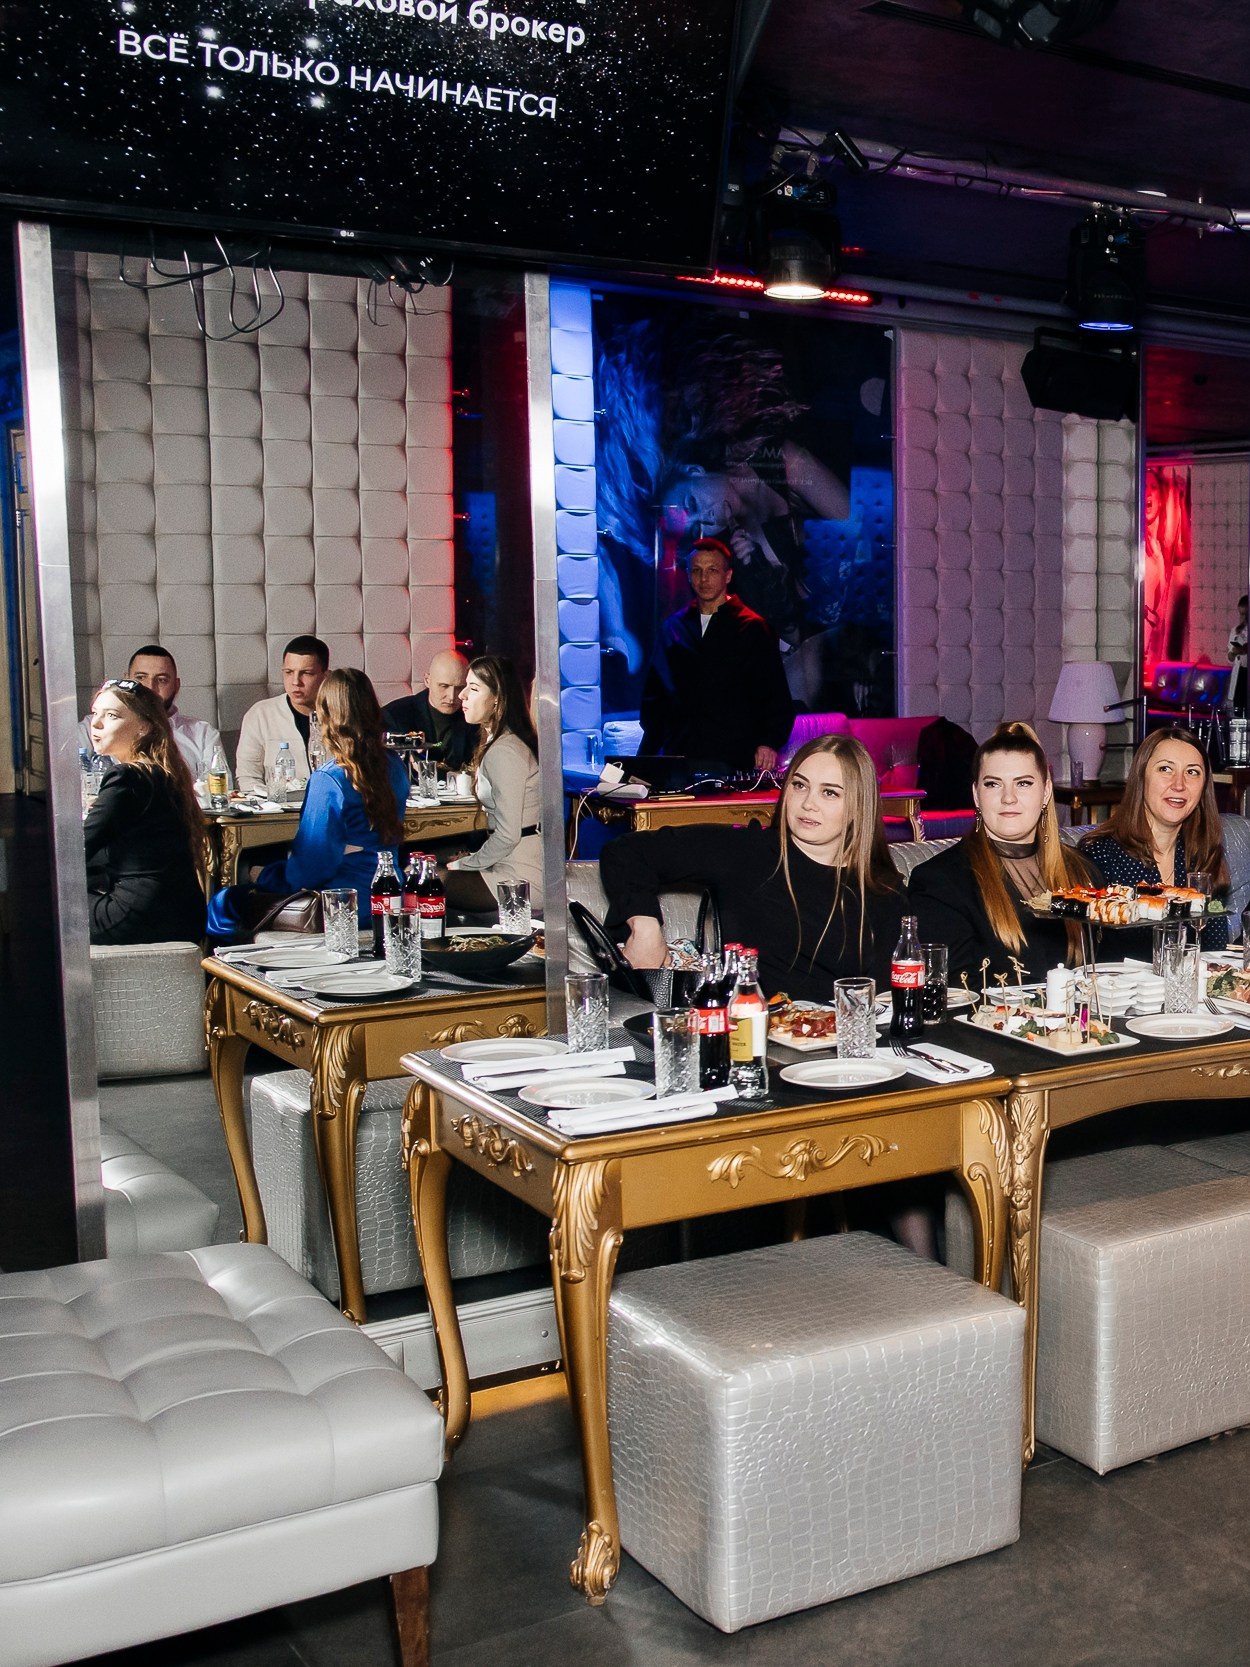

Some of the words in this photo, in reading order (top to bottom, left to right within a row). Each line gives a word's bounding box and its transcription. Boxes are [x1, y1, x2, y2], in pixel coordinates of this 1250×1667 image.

[469, 0, 586, 54] брокер
[118, 29, 189, 63] ВСЁ
[198, 41, 340, 85] ТОЛЬКО
[350, 66, 557, 119] НАЧИНАЕТСЯ
